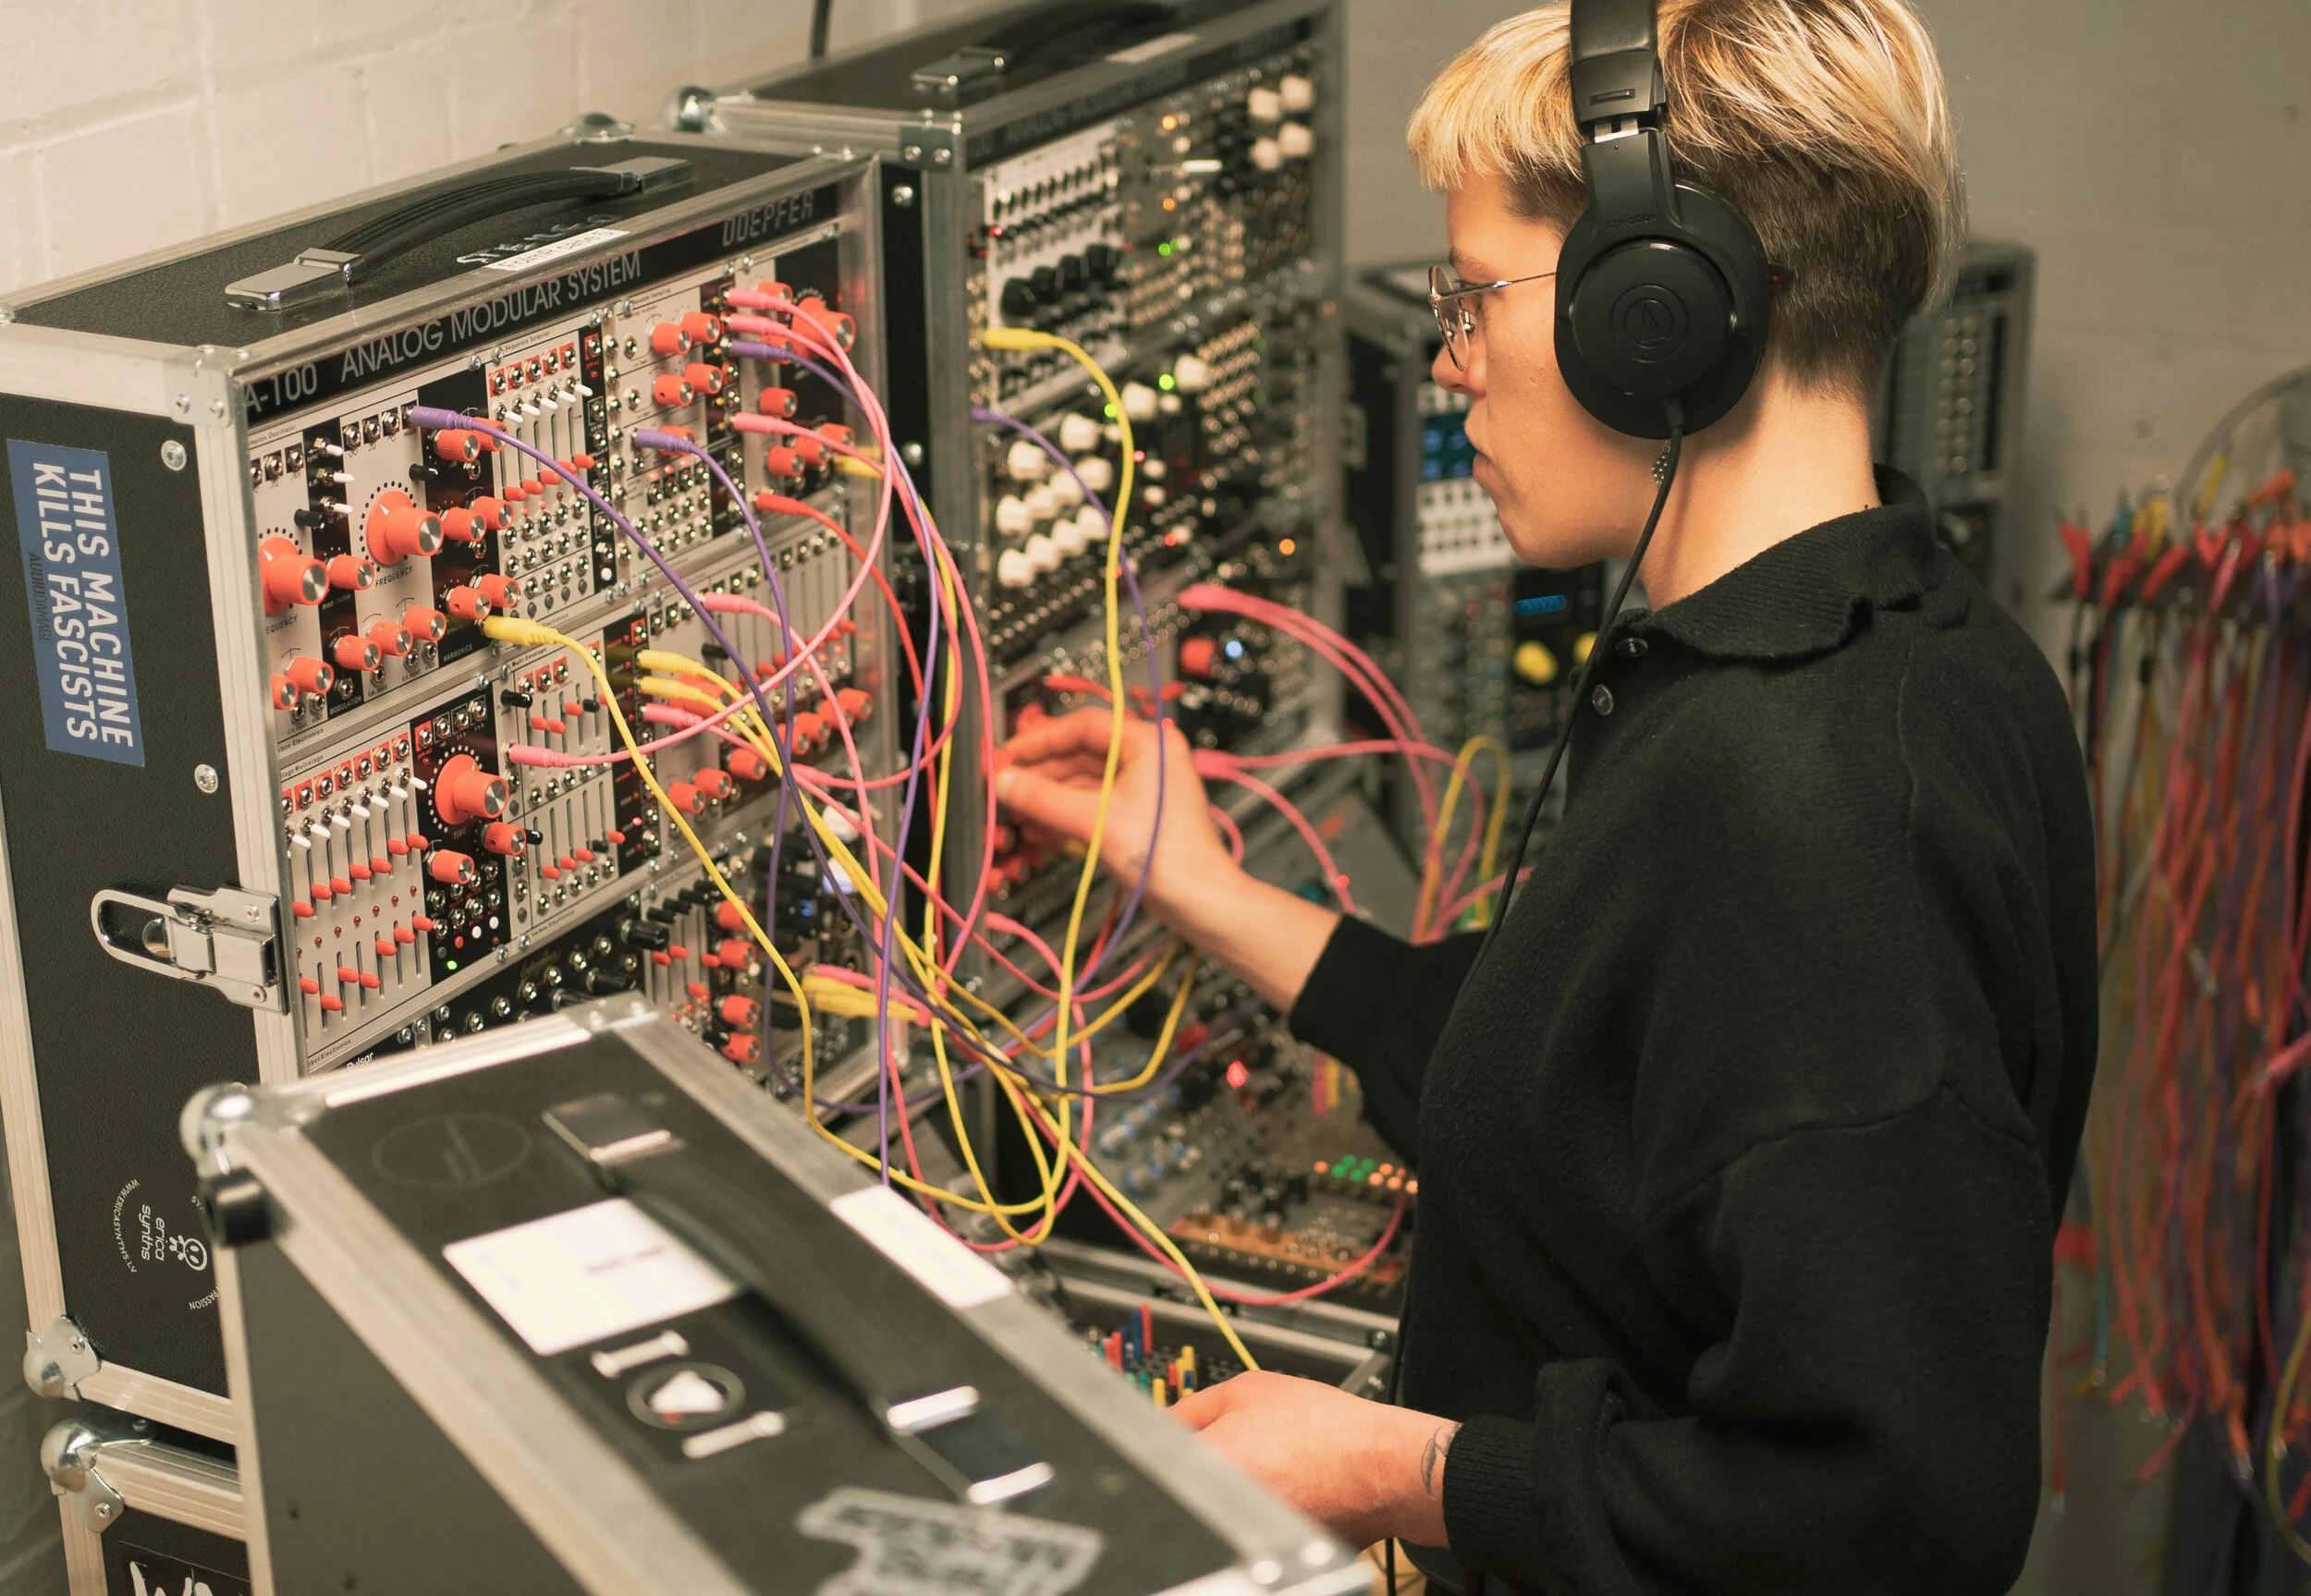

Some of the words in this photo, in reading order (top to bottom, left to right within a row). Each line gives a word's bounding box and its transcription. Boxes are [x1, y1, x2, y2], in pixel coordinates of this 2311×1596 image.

[722, 189, 814, 247] DOEPFER
[244, 363, 317, 412] A-100
[341, 320, 443, 382] ANALOG
[451, 278, 561, 342] MODULAR
[568, 250, 641, 300] SYSTEM
[33, 462, 76, 564] KILLS
[69, 469, 110, 556] THIS
[375, 565, 413, 588] FREQUENCY
[47, 574, 98, 740] FASCISTS
[81, 571, 134, 748] MACHINE
[265, 614, 298, 635] EQUENCY
[113, 1177, 141, 1273] WWW.ERICASYNTHS.LV
[139, 1204, 153, 1261] synths
[154, 1217, 168, 1261] erica
